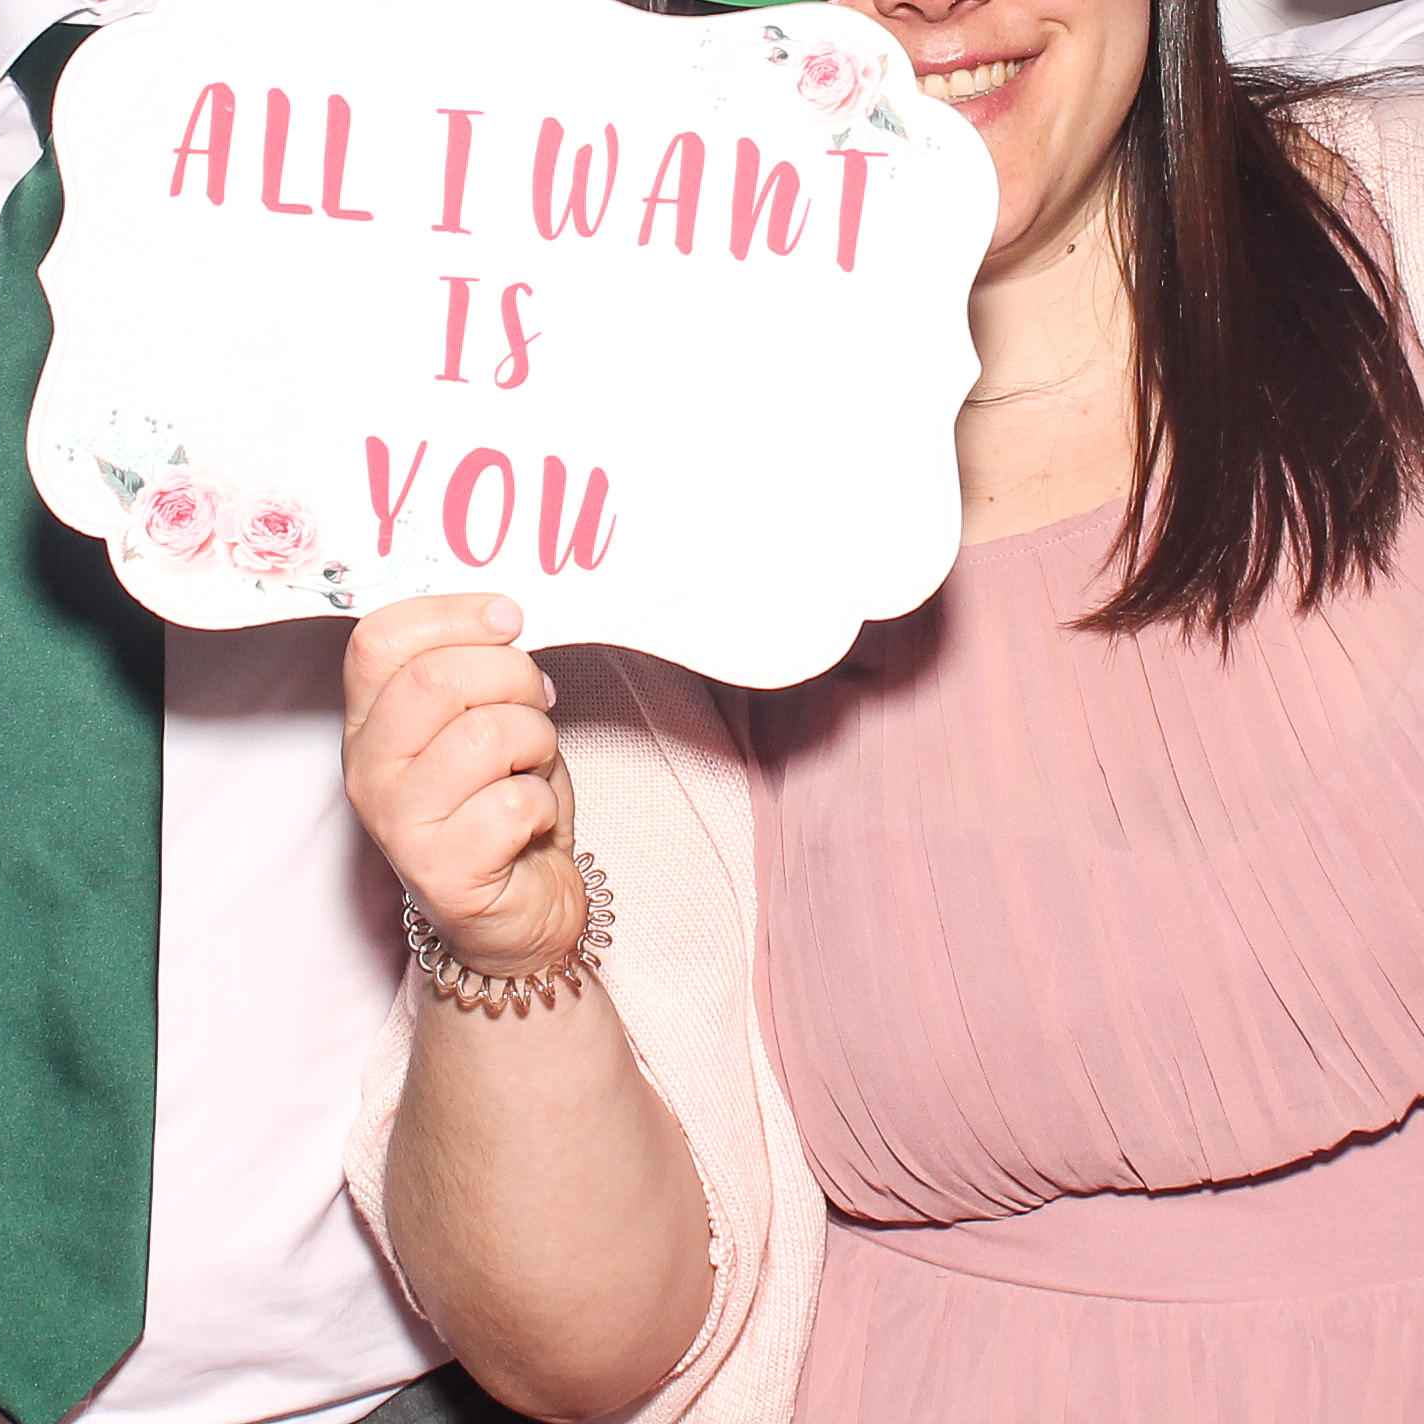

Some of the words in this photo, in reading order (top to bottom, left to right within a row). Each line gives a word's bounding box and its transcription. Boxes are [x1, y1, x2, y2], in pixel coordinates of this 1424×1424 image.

[169, 82, 373, 222] ALL
[431, 108, 484, 235] I
[435, 276, 542, 390] IS
[364, 435, 617, 576] YOU
